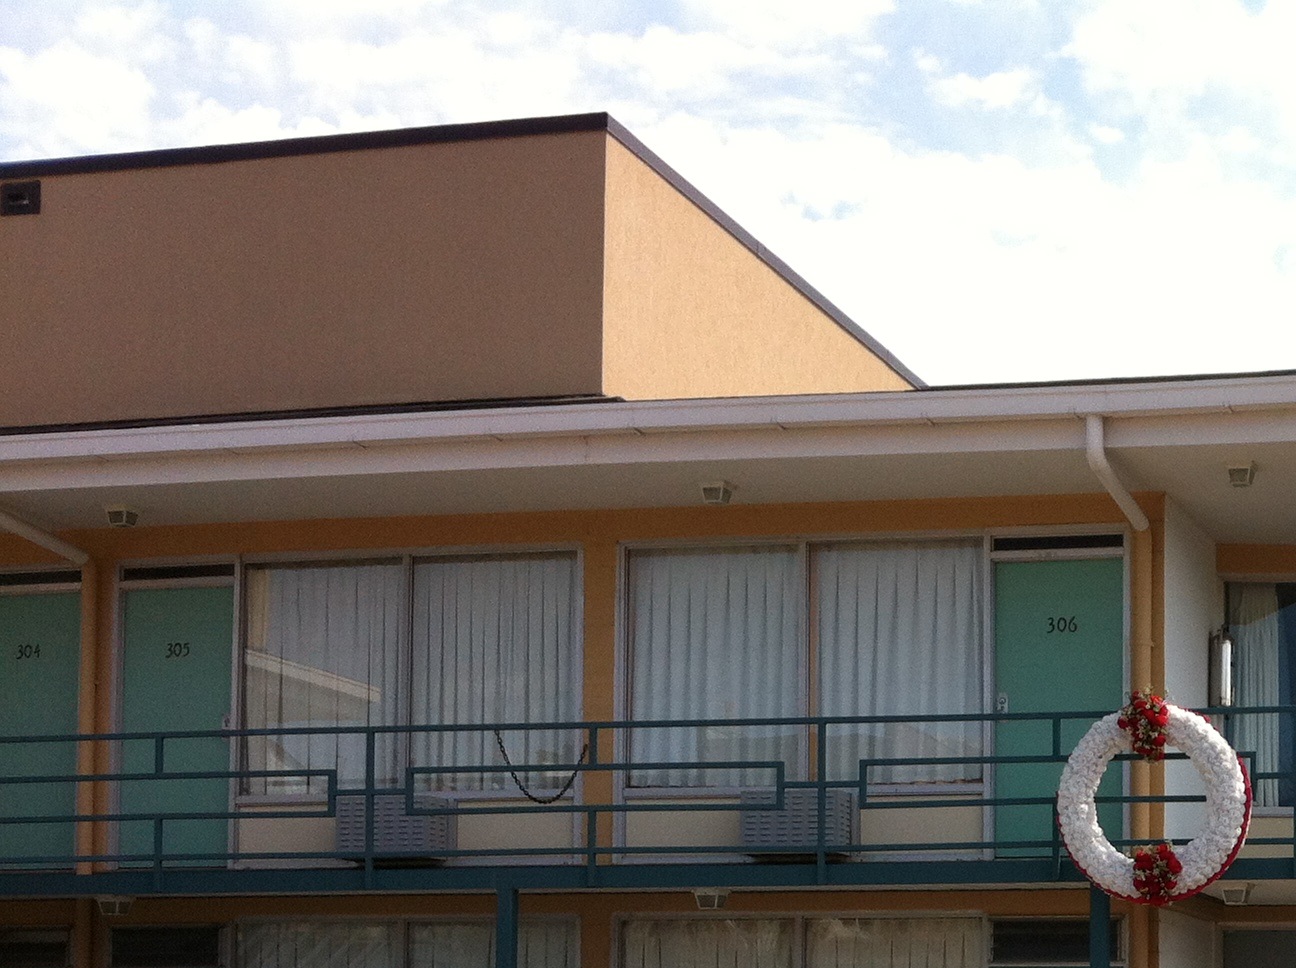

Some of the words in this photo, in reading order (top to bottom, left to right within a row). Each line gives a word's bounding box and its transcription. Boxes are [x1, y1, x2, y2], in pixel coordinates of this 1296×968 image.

[1046, 616, 1078, 634] 306
[15, 643, 41, 660] 304
[164, 642, 190, 659] 305
